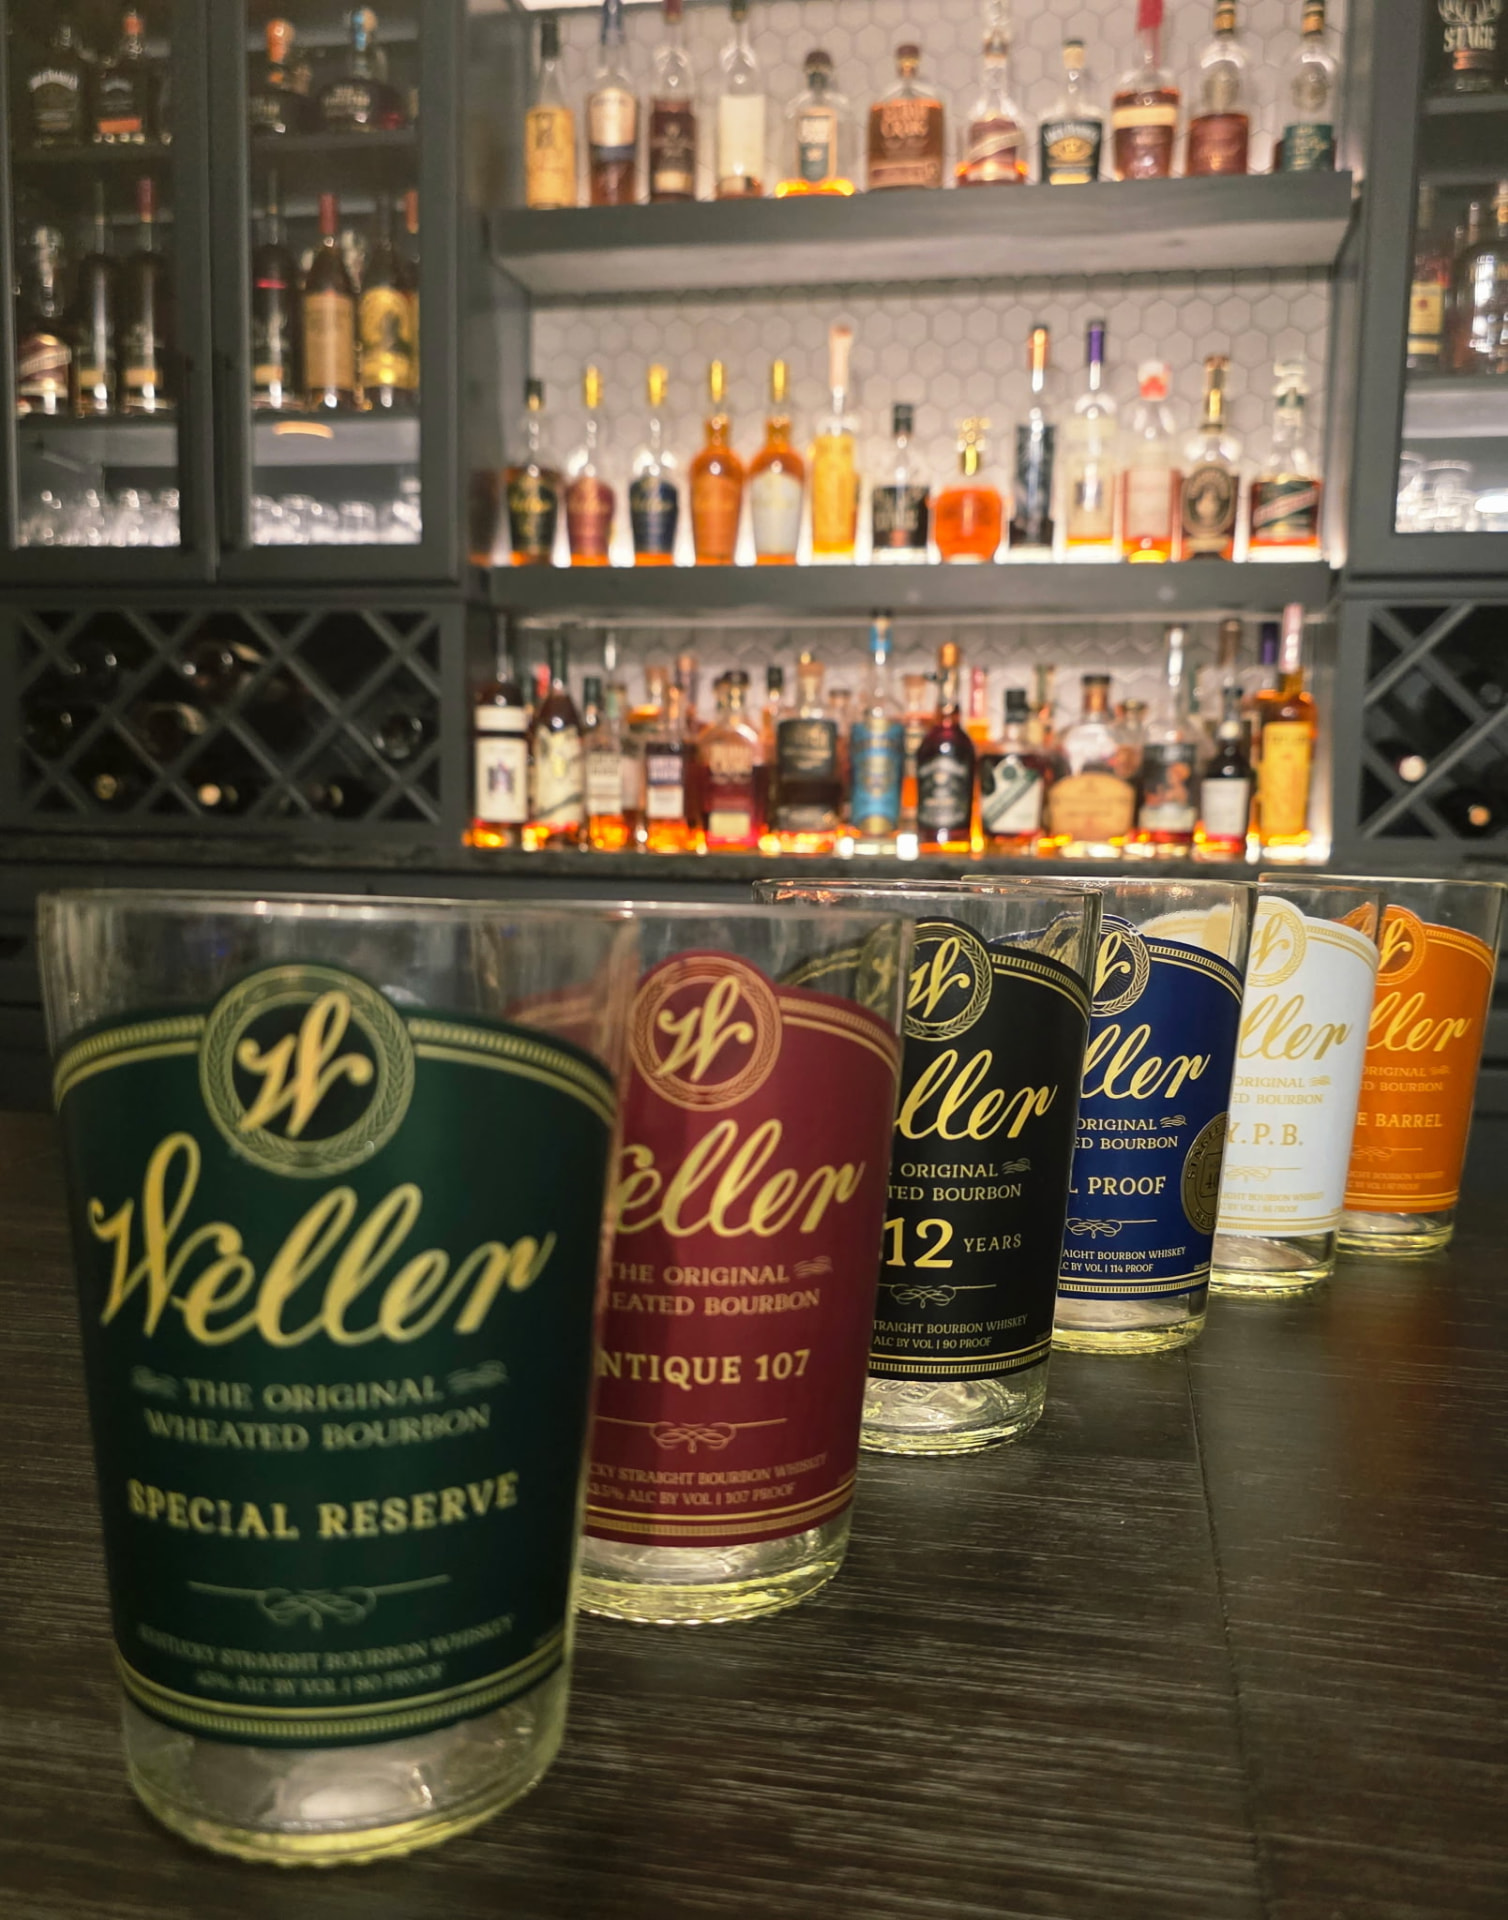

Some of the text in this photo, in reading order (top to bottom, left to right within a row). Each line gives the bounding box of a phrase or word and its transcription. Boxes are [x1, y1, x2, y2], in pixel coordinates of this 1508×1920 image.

[657, 974, 755, 1083] W
[1239, 993, 1352, 1061] ller
[1366, 991, 1472, 1052] ller
[1081, 1023, 1211, 1100] ller
[1234, 1076, 1305, 1088] ORIGINAL
[1380, 1081, 1444, 1092] BOURBON
[894, 1049, 1058, 1141] ller
[1256, 1093, 1324, 1105] BOURBON
[1077, 1117, 1158, 1131] ORIGINAL
[1375, 1113, 1443, 1128] BARREL
[1100, 1135, 1179, 1150] BOURBON
[1227, 1121, 1304, 1147] Y.P.B.
[615, 1119, 866, 1238] eller
[900, 1162, 999, 1179] ORIGINAL
[932, 1183, 1022, 1202] BOURBON
[1088, 1175, 1167, 1196] PROOF
[88, 1132, 556, 1347] Weller
[884, 1216, 1022, 1269] 12 YEARS
[1062, 1246, 1186, 1261] AIGHT BOURBON WHISKEY
[663, 1264, 791, 1287] ORIGINAL
[1071, 1262, 1082, 1272] BY
[1084, 1263, 1102, 1273] VOL
[1110, 1264, 1124, 1273] 114
[1125, 1263, 1154, 1273] PROOF
[611, 1289, 820, 1316] EATED BOURBON
[873, 1313, 1028, 1335] TRAIGHT BOURBON WHISKEY
[874, 1335, 896, 1347] ALC
[896, 1337, 910, 1349] BY
[912, 1339, 933, 1350] VOL
[943, 1339, 957, 1350] 90
[959, 1336, 993, 1349] PROOF
[599, 1349, 811, 1391] NTIQUE 107
[183, 1376, 443, 1413] THE ORIGINAL
[144, 1403, 491, 1451] WHEATED BOURBON
[618, 1469, 695, 1485] STRAIGHT
[698, 1468, 772, 1486] BOURBON
[127, 1471, 519, 1540] SPECIAL RESERVE
[627, 1489, 657, 1504] ALC
[659, 1491, 678, 1506] BY
[683, 1491, 713, 1506] VOL
[752, 1482, 797, 1502] PROOF
